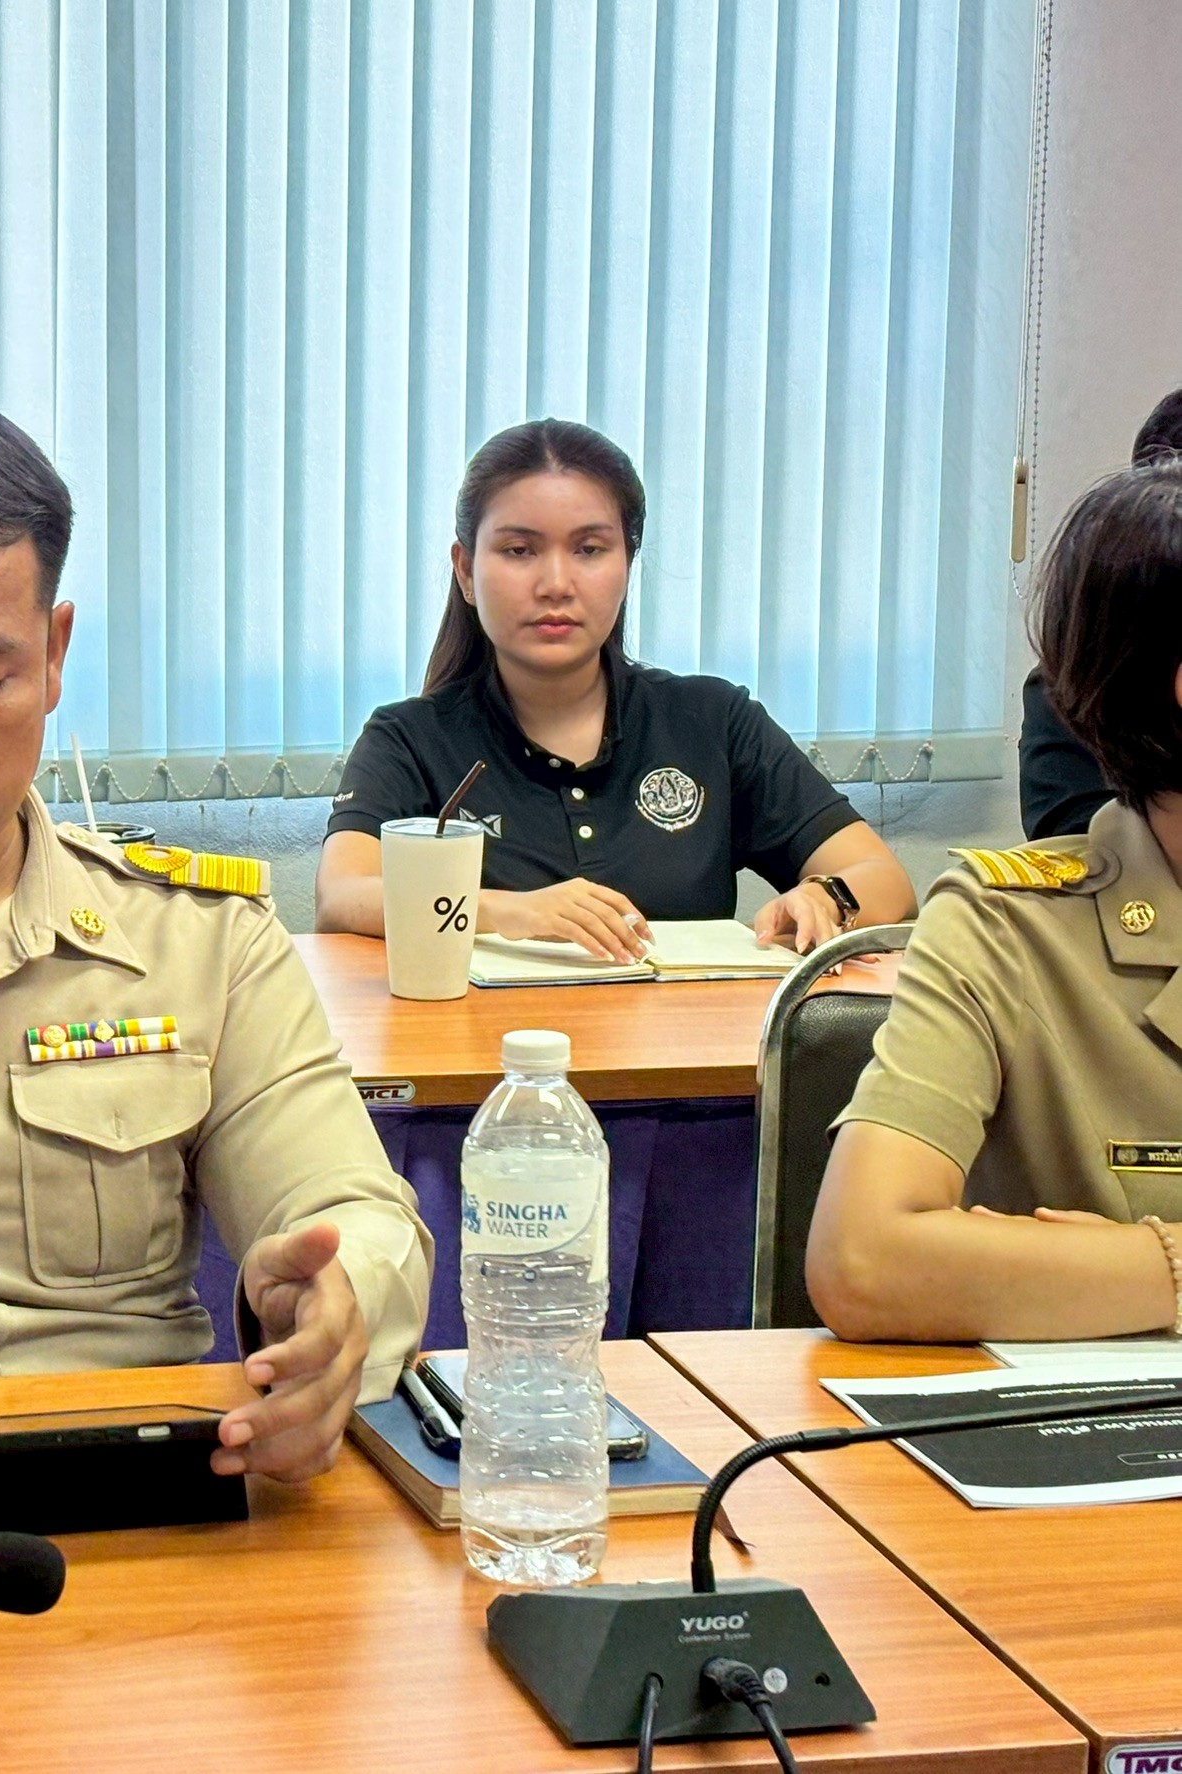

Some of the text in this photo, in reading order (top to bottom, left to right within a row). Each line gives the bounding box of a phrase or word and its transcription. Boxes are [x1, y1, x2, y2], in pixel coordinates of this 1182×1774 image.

[358, 1084, 409, 1100] MCL
[486, 1201, 568, 1221] SINGHA
[486, 1219, 549, 1239] WATER
[680, 1614, 745, 1633] YUGO
